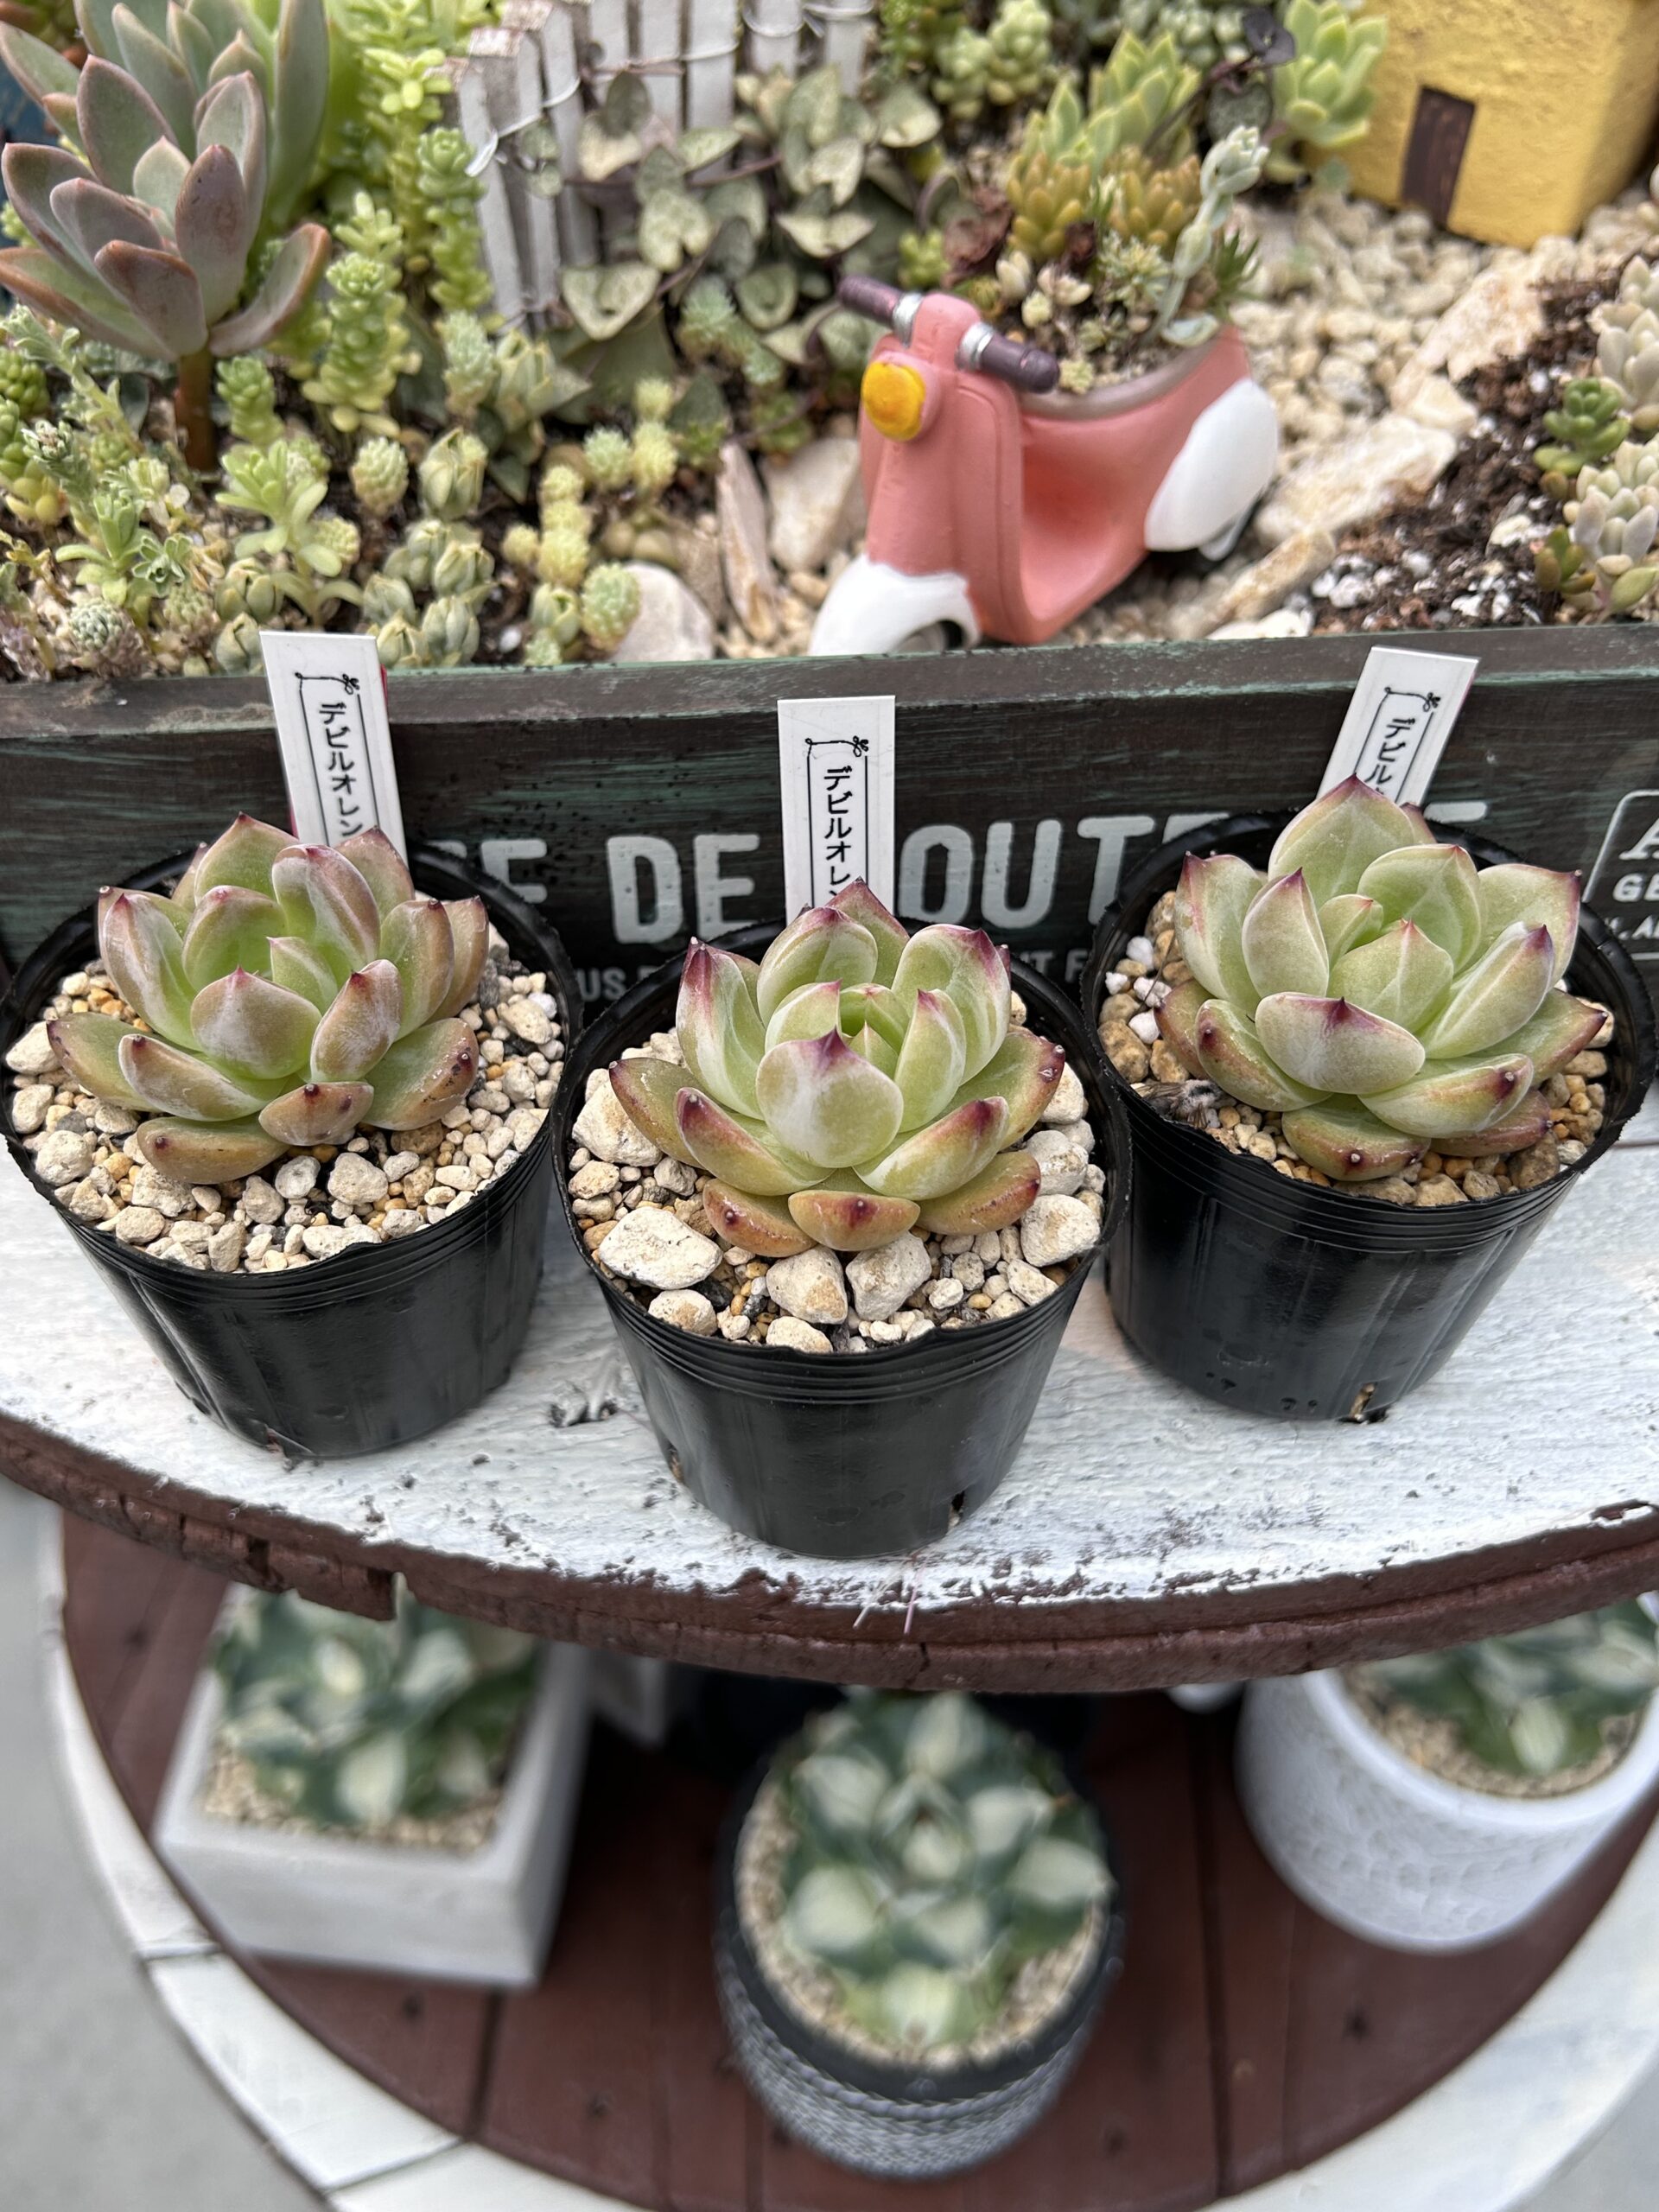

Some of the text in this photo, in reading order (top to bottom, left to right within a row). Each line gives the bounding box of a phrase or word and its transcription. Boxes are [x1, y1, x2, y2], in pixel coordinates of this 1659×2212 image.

[319, 701, 364, 837] デビルオレン
[1363, 717, 1416, 794] デビル
[607, 833, 761, 944] DE
[897, 812, 1230, 930] OUT
[823, 765, 854, 896] デビルオレ
